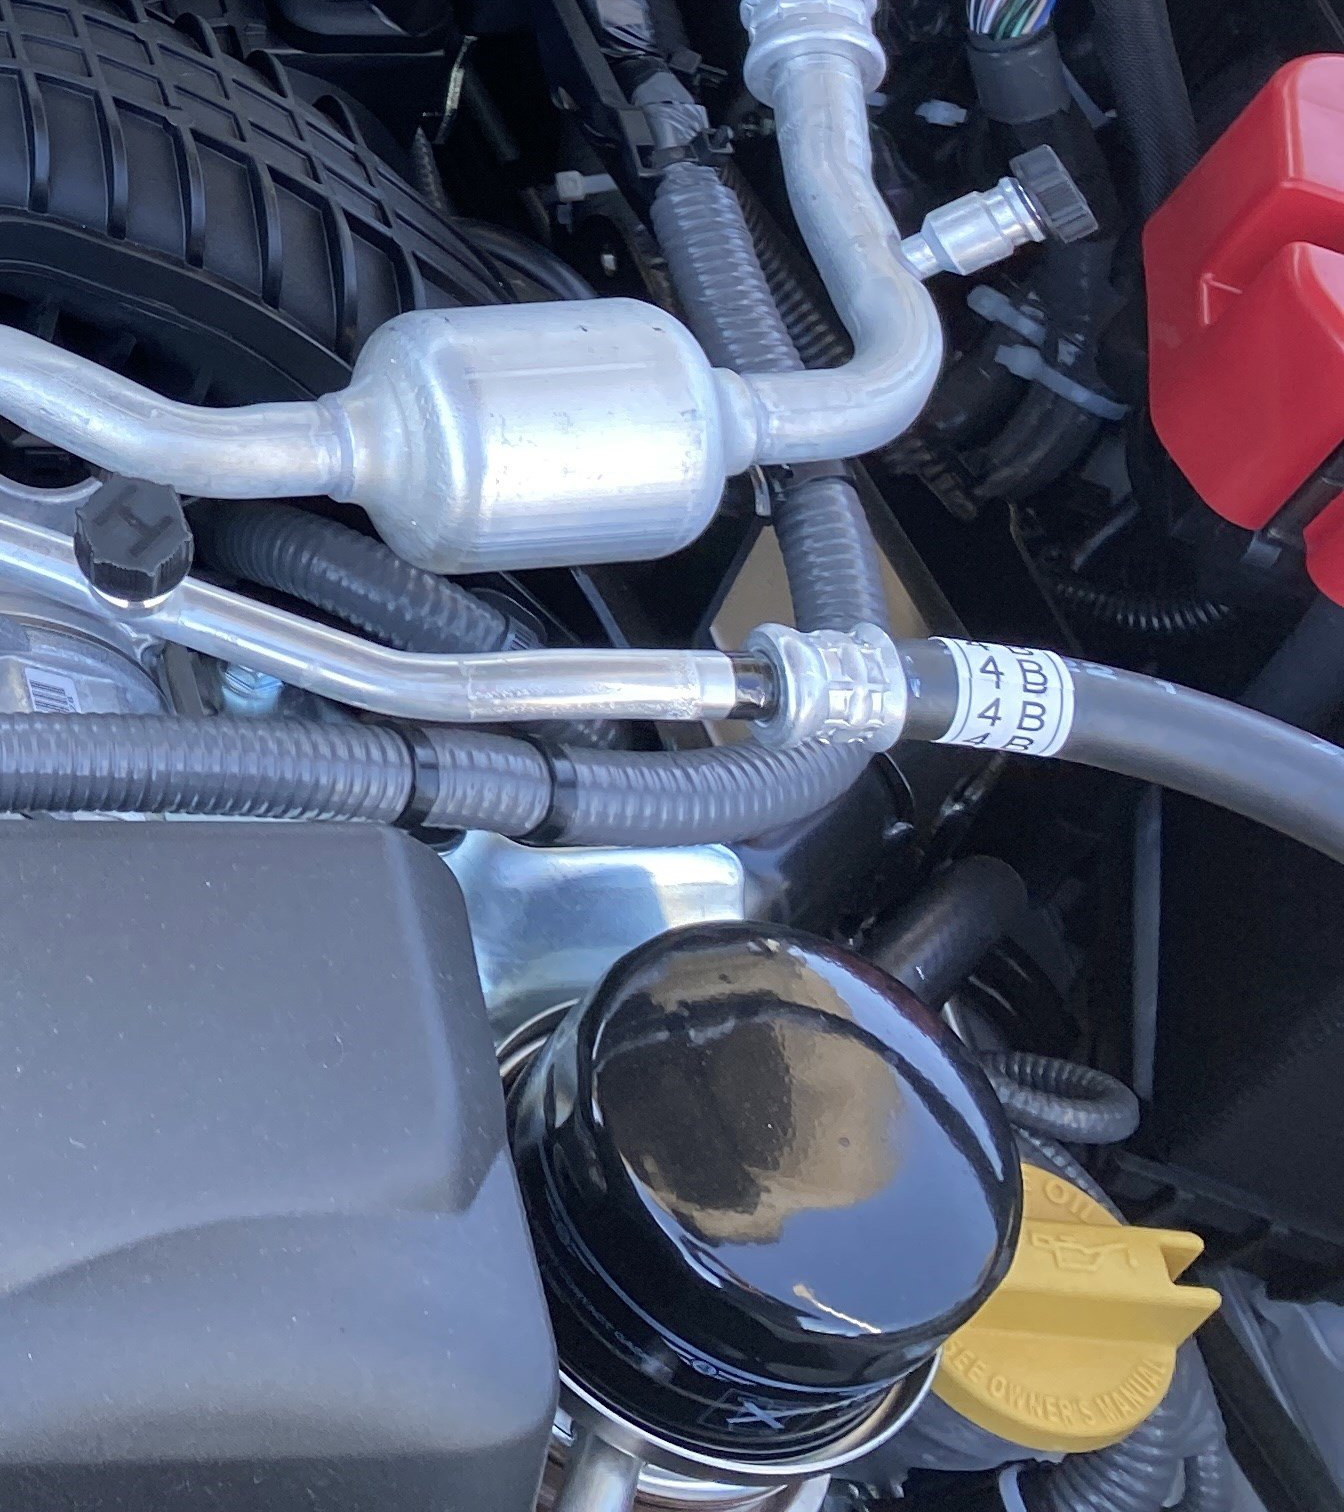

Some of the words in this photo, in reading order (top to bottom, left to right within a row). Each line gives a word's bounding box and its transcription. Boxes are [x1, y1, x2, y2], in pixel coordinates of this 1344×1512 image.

[943, 1339, 988, 1386] SEE
[987, 1373, 1097, 1429] OWNER'S
[1095, 1356, 1167, 1426] MANUAL
